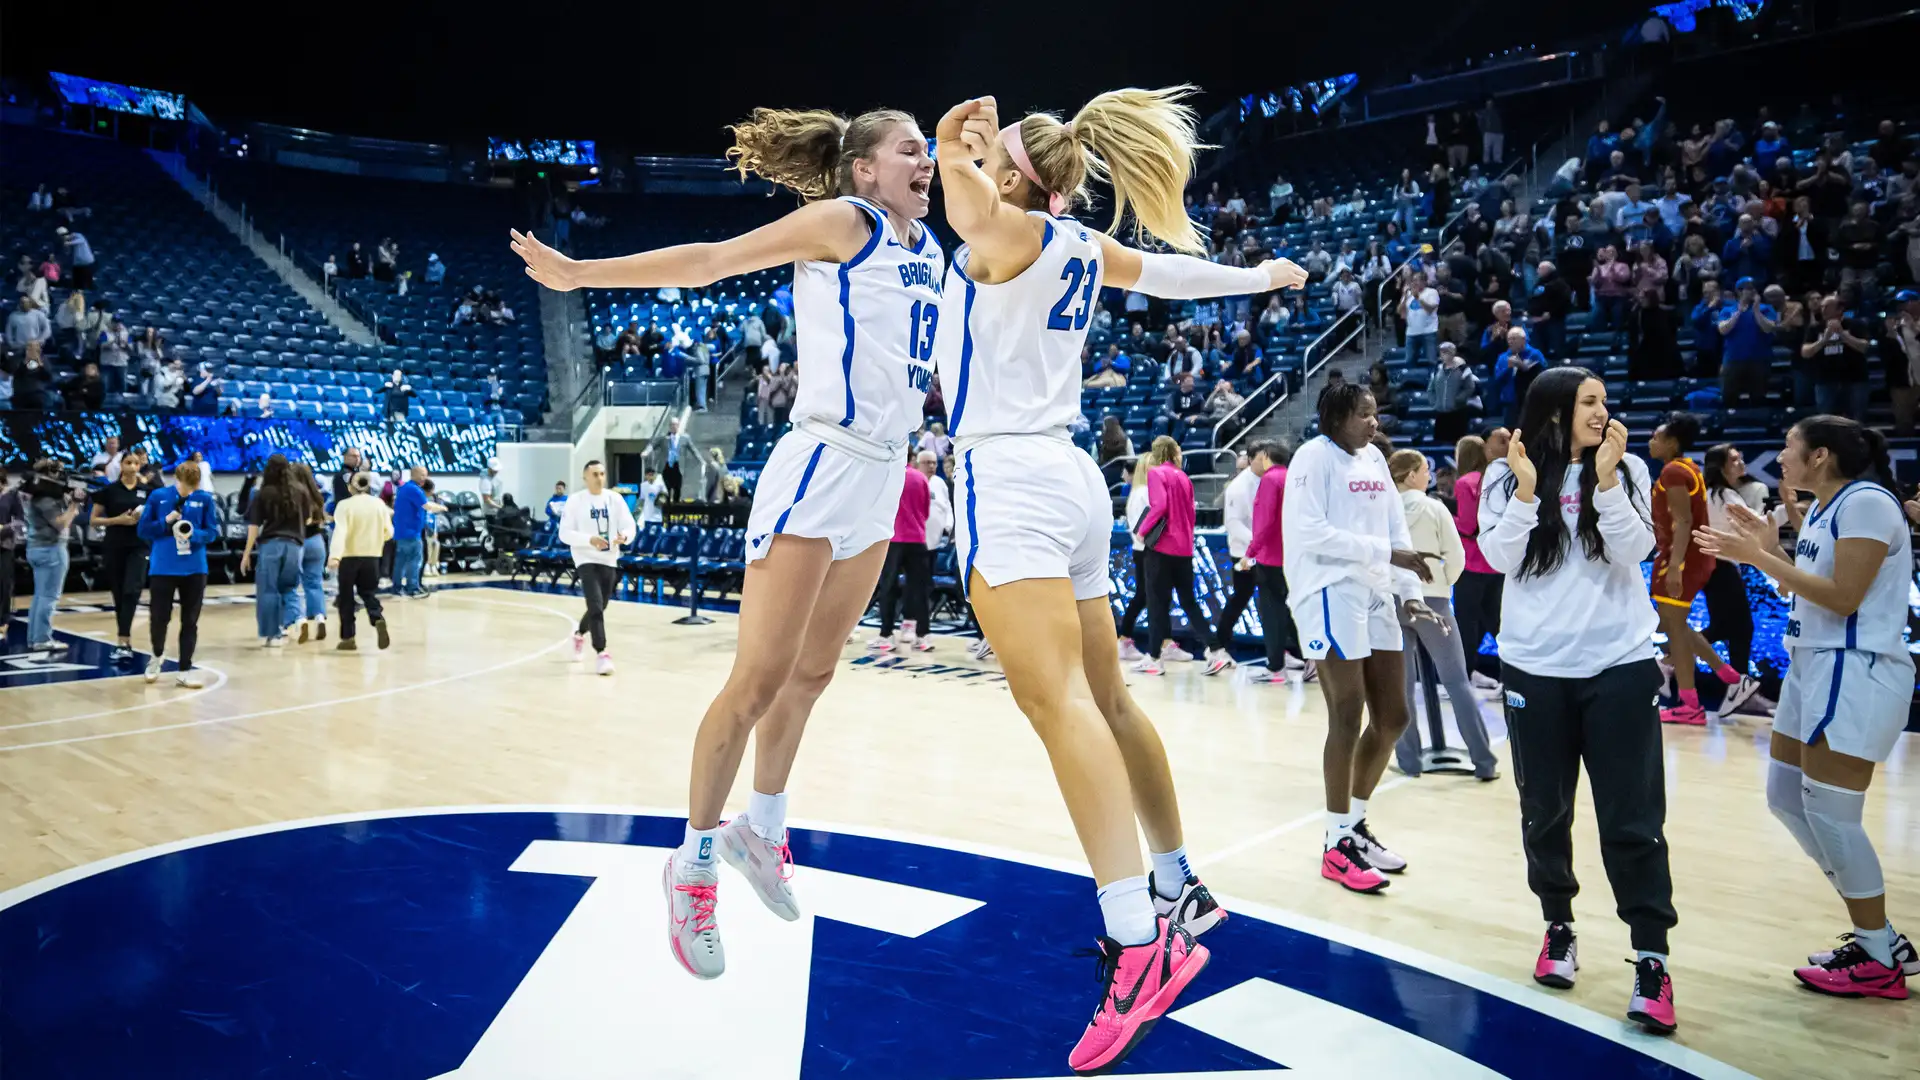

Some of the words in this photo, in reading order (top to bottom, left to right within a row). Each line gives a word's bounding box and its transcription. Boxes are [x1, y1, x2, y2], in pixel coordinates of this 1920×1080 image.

[898, 262, 943, 299] BRIGHAM
[1047, 257, 1098, 331] 23
[910, 300, 939, 362] 13
